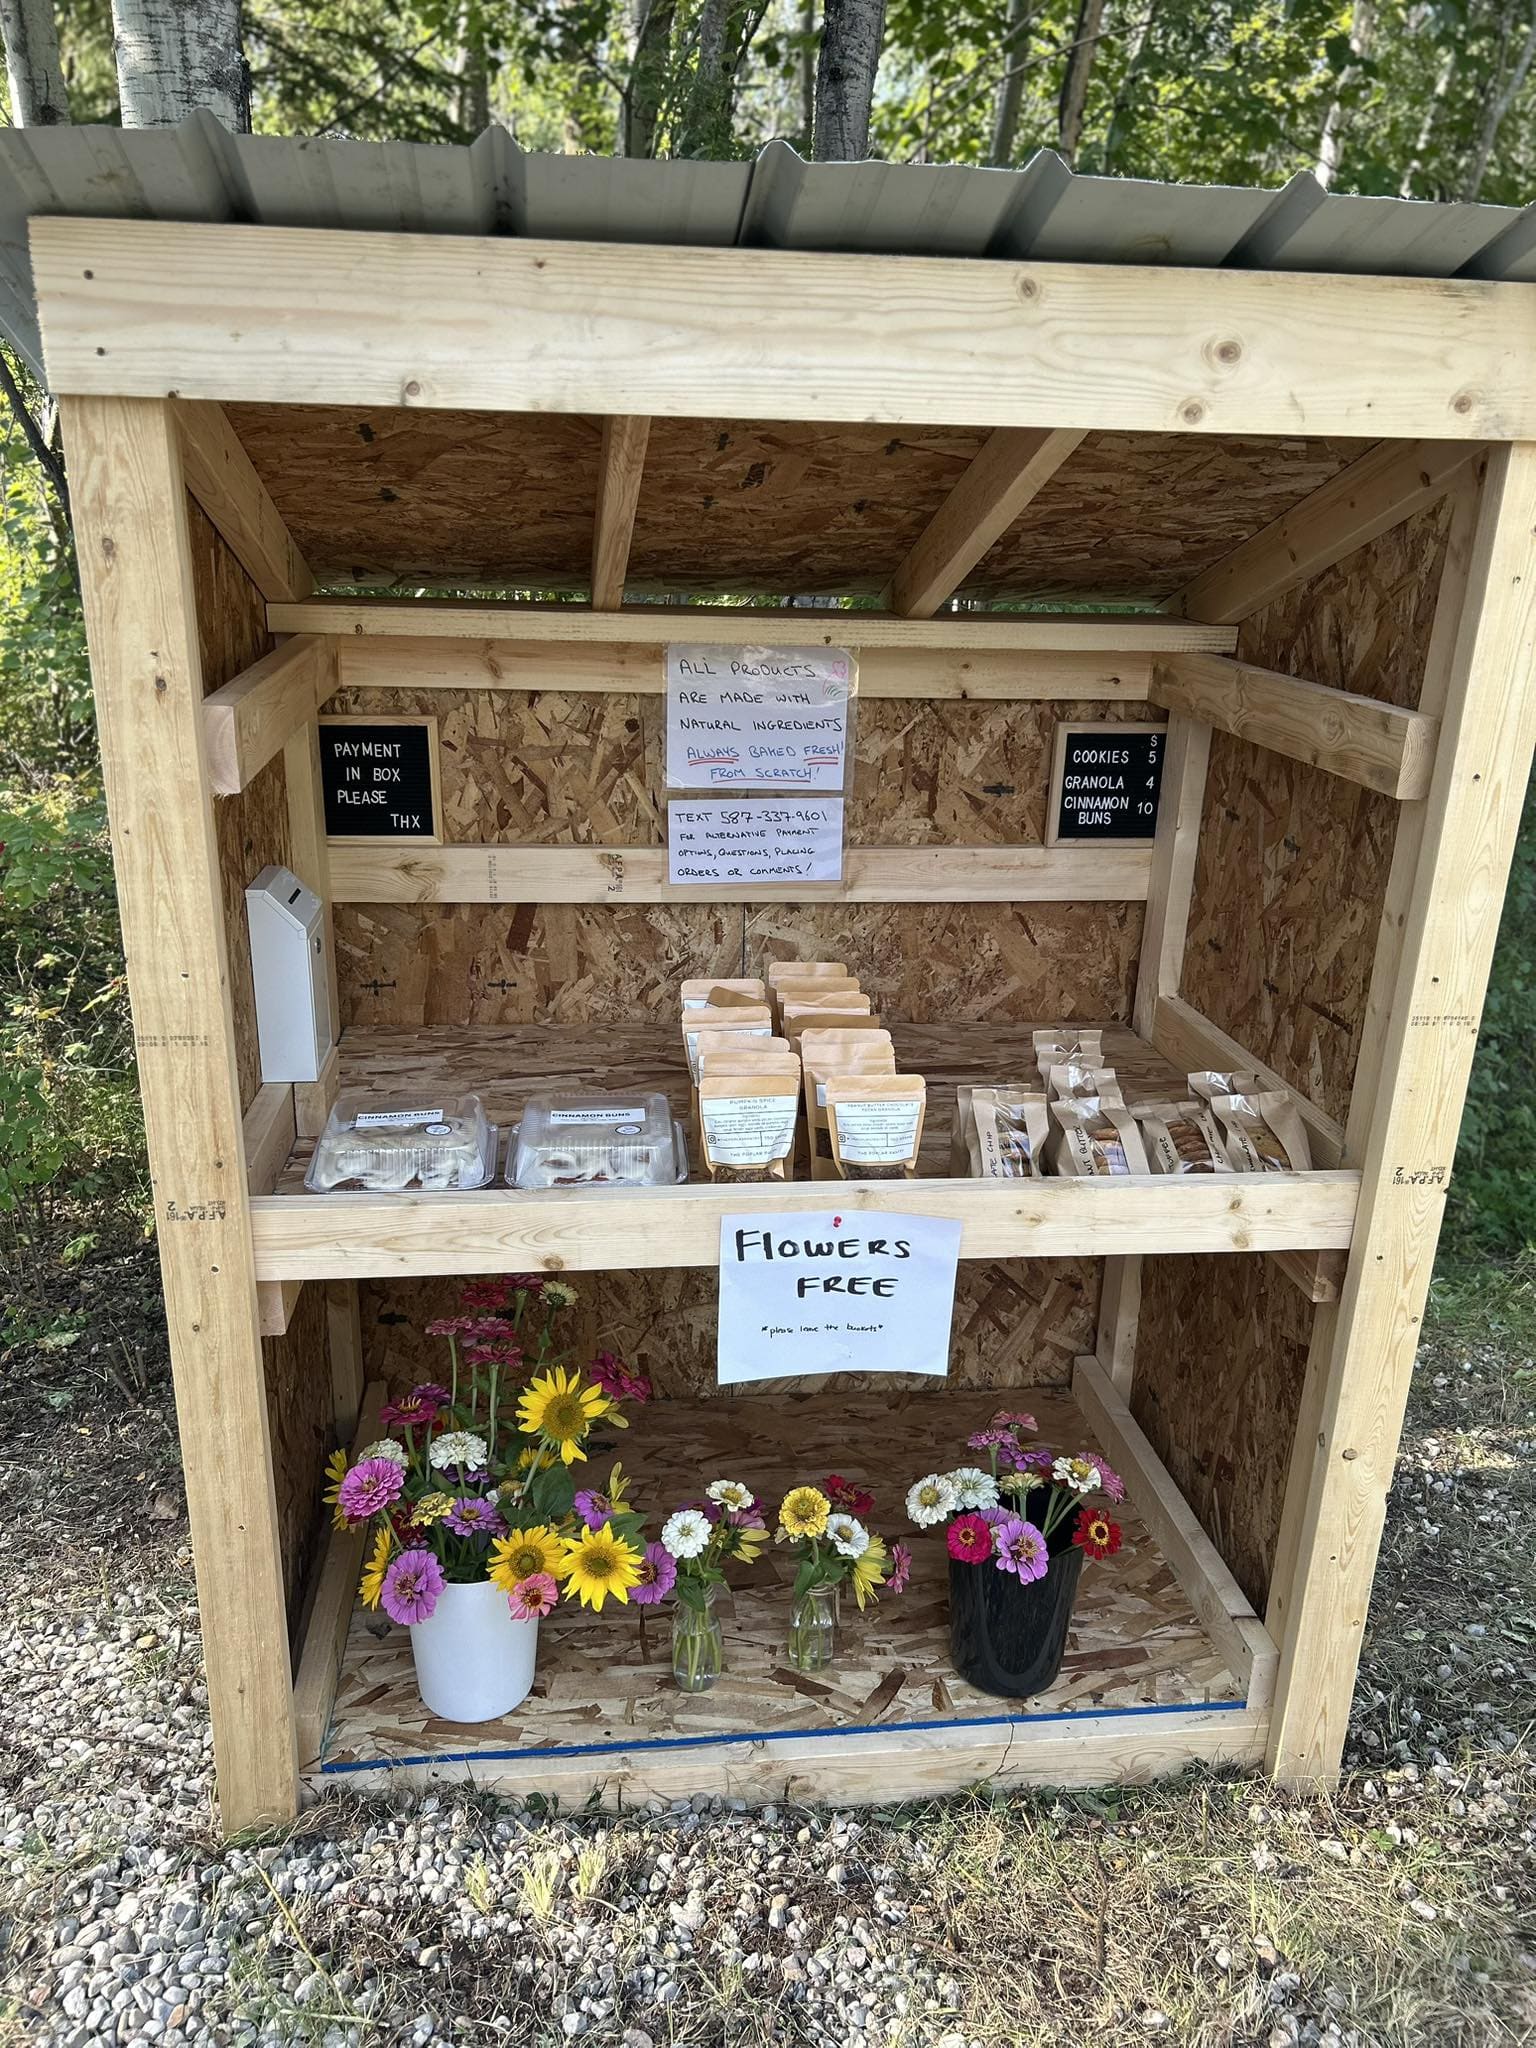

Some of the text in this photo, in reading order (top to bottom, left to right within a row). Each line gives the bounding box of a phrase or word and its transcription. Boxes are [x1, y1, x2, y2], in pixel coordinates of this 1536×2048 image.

[679, 657, 817, 678] ALL PRODUCTS
[679, 691, 811, 704] ARE MADE WITH
[680, 718, 843, 732] NATURAL INGREDIENTS
[334, 741, 401, 758] PAYMENT
[687, 746, 740, 759] ALWAYS
[750, 746, 797, 758] BAKED
[1073, 750, 1157, 764] COOKIES 5
[346, 766, 401, 782] IN BOX
[710, 767, 820, 780] FROM SCRATCH!
[1065, 775, 1154, 789] GRANOLA 4
[337, 789, 388, 805] PLEASE
[1064, 796, 1153, 815] CINNAMON 10
[390, 813, 421, 829] THX
[675, 811, 828, 824] TEXT 587-337-9601
[1078, 811, 1112, 825] BUNS
[680, 828, 819, 841] FOR ALTERNATIVE PAYMENT
[718, 848, 772, 859] QUESTIONS,
[774, 847, 816, 857] PLACING
[677, 868, 720, 877] ORDERS
[727, 868, 743, 876] OR
[1396, 1167, 1405, 1176] 2
[167, 1201, 176, 1211] 2
[797, 1276, 899, 1298] FREE
